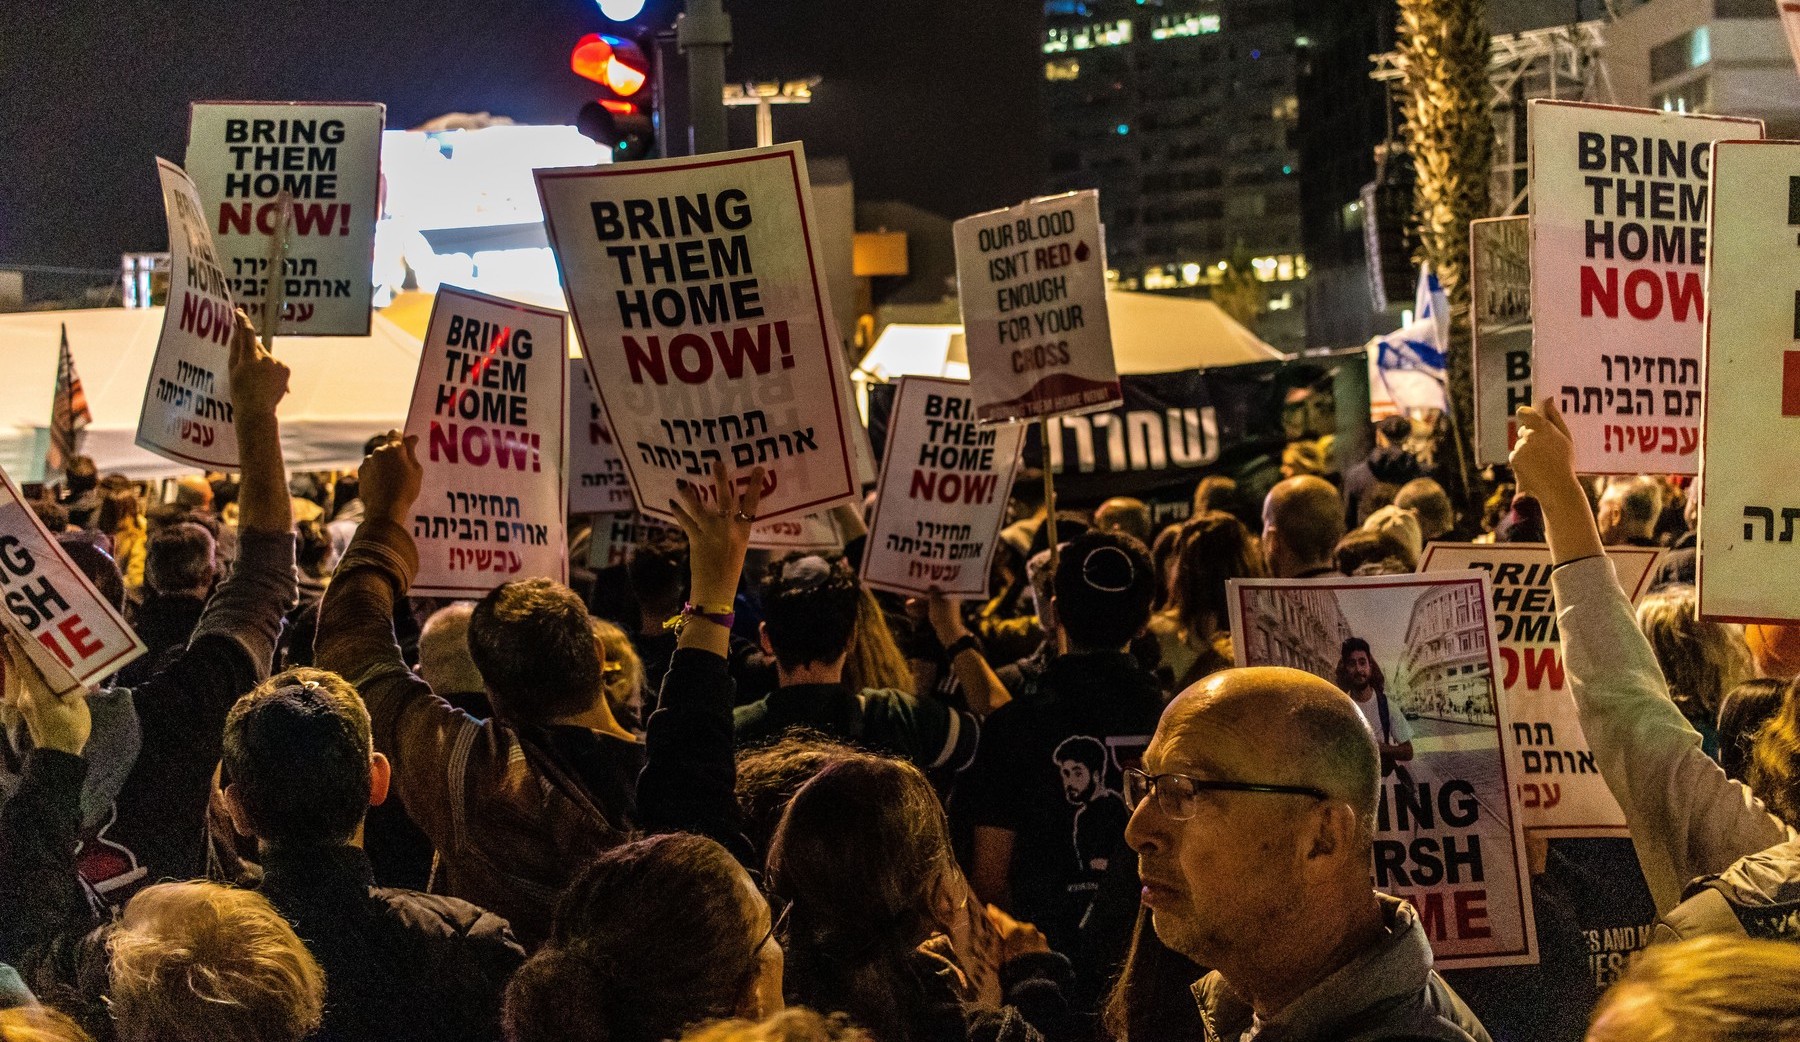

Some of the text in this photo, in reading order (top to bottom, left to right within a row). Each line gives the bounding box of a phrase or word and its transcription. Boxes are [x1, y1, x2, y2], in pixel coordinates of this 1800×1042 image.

[225, 119, 345, 144] BRING
[229, 146, 337, 171] THEM
[1578, 131, 1710, 181] BRING
[225, 173, 337, 199] HOME
[1584, 175, 1709, 223] THEM
[218, 202, 350, 236] NOW!
[590, 188, 753, 241] BRING
[978, 209, 1075, 253] OUR BLOOD
[1585, 219, 1707, 265] HOME
[233, 258, 317, 276] תחירו
[606, 234, 753, 286] THEM
[989, 242, 1072, 283] ISN'T RED
[285, 279, 350, 298] אותם
[616, 278, 764, 330] HOME
[997, 275, 1069, 313] ENOUGH
[446, 315, 533, 360] BRING
[998, 304, 1085, 345] FOR YOUR
[445, 349, 527, 393] THEM
[621, 320, 795, 387] NOW!
[1011, 341, 1071, 374] CROSS
[1601, 354, 1698, 384] תחזירו
[434, 384, 528, 427] HOME
[924, 394, 975, 422] BRI
[1561, 385, 1653, 415] הביתה
[660, 410, 768, 445] תחזירו
[926, 420, 997, 446] THEM
[1604, 424, 1698, 455] עכשיו!
[429, 420, 541, 473] NOW!
[637, 427, 818, 475] אותם הביתה
[918, 444, 995, 471] HOME
[909, 469, 998, 505] NOW!
[446, 491, 520, 519] תחזירו
[414, 515, 548, 546] אותם הביתה
[886, 534, 945, 559] הביתה
[916, 520, 971, 540] תחזירו
[449, 547, 522, 574] עכשיו!
[1522, 750, 1598, 774] אותם
[1377, 779, 1480, 832] ING
[1372, 834, 1484, 887] RSH
[1403, 889, 1492, 942] ME
